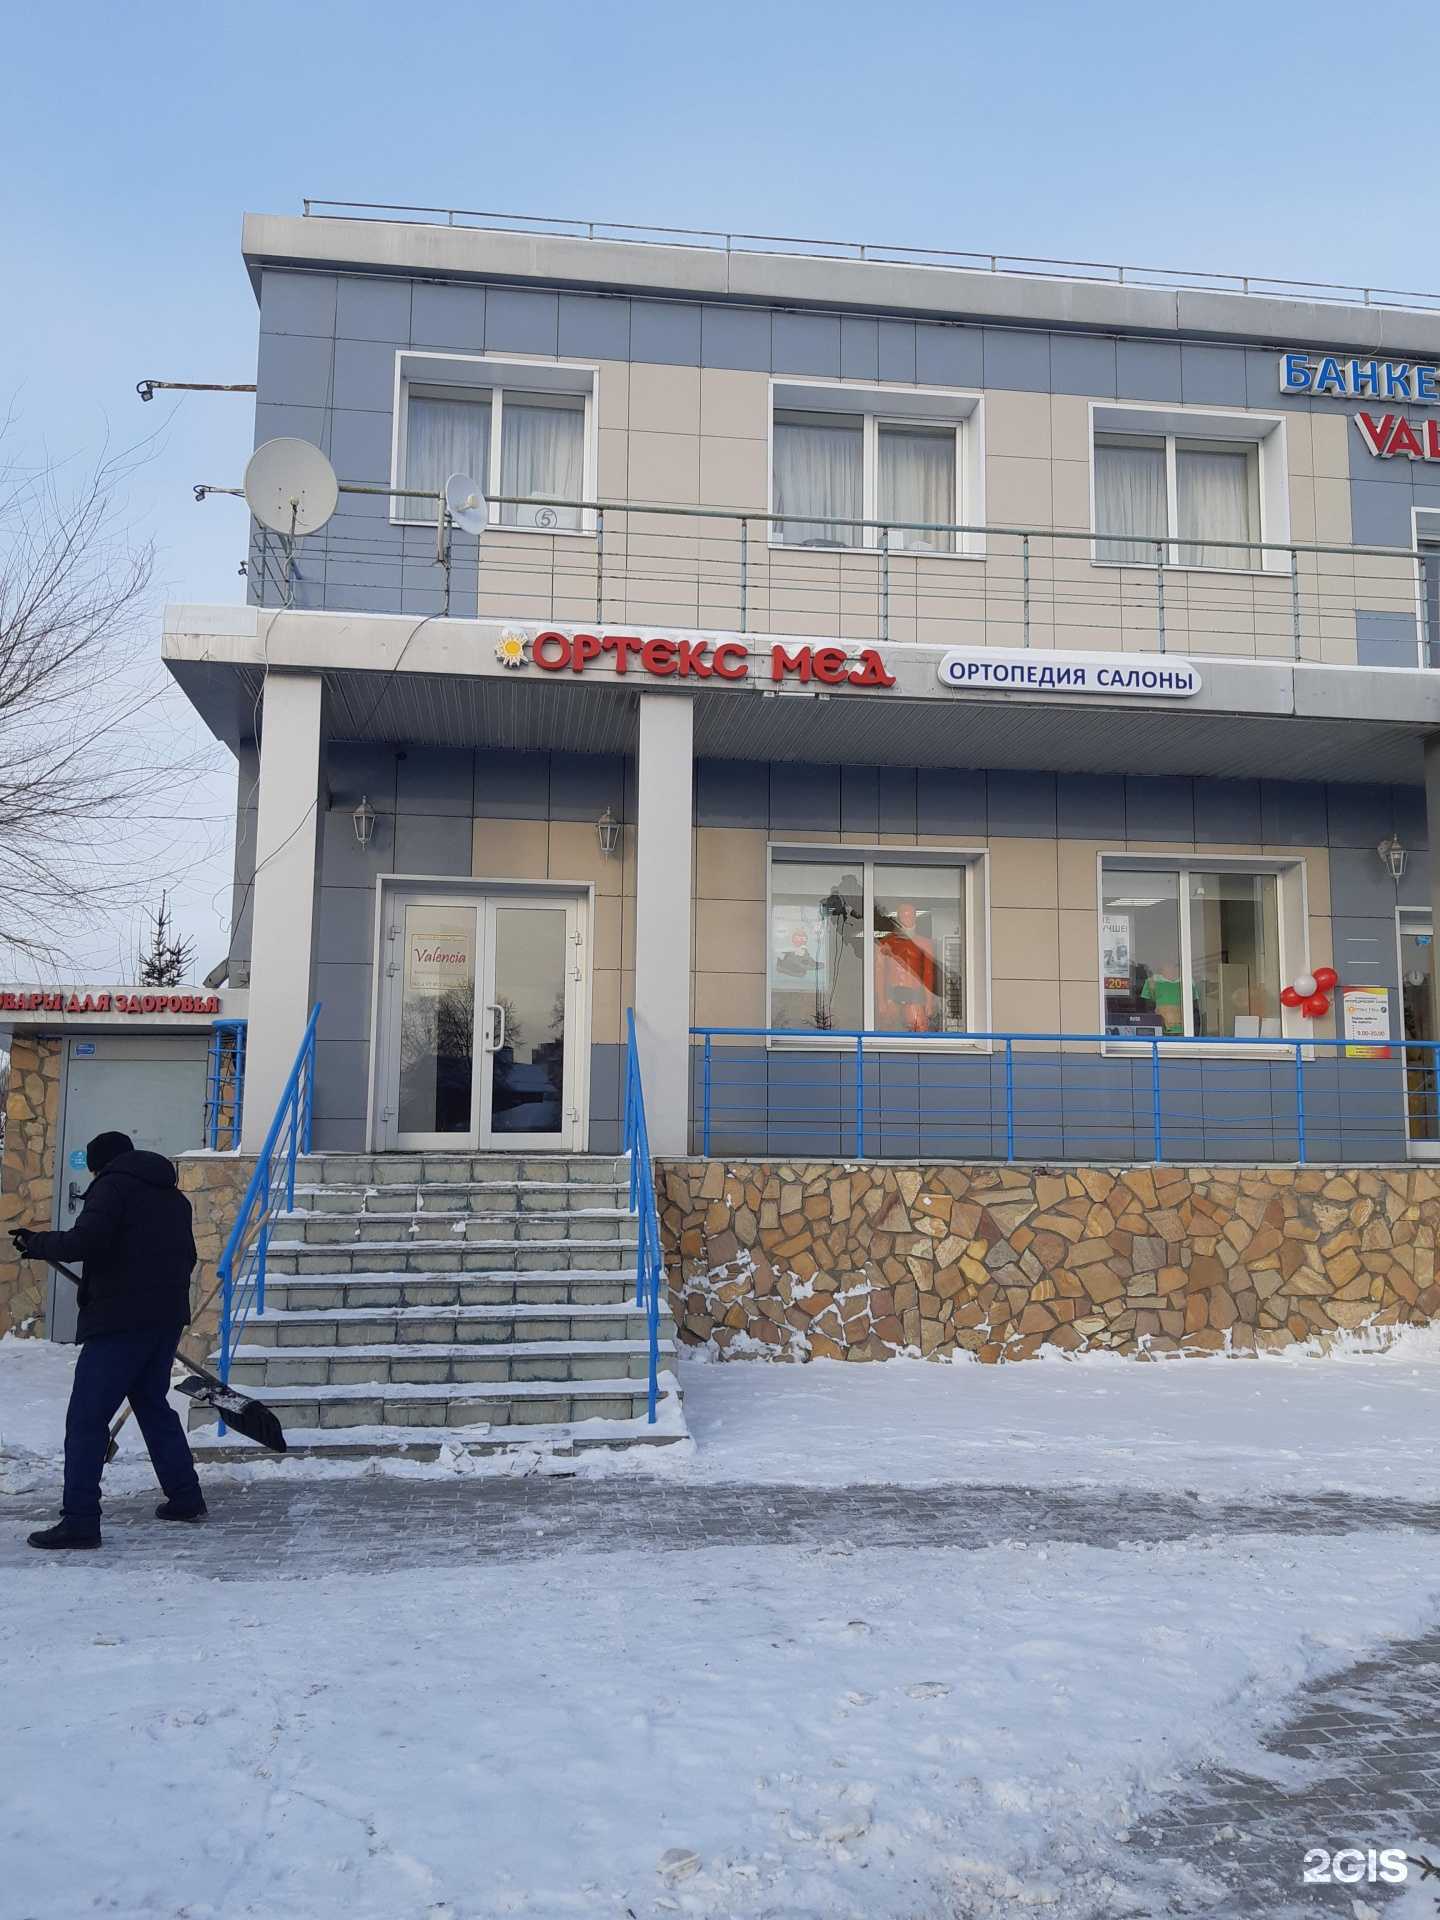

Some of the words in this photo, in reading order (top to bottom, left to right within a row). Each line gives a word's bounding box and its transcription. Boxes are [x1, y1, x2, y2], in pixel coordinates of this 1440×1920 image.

[532, 631, 749, 679] ОРТЕКС
[771, 644, 897, 688] МЕД
[949, 662, 1086, 688] ОРТОПЕДИЯ
[1096, 668, 1194, 690] САЛОНЫ
[413, 946, 466, 964] Valencia
[0, 992, 62, 1010] ВАРЫ
[64, 992, 111, 1013] ДЛЯ
[115, 995, 219, 1014] ЗДОРОВЬЯ
